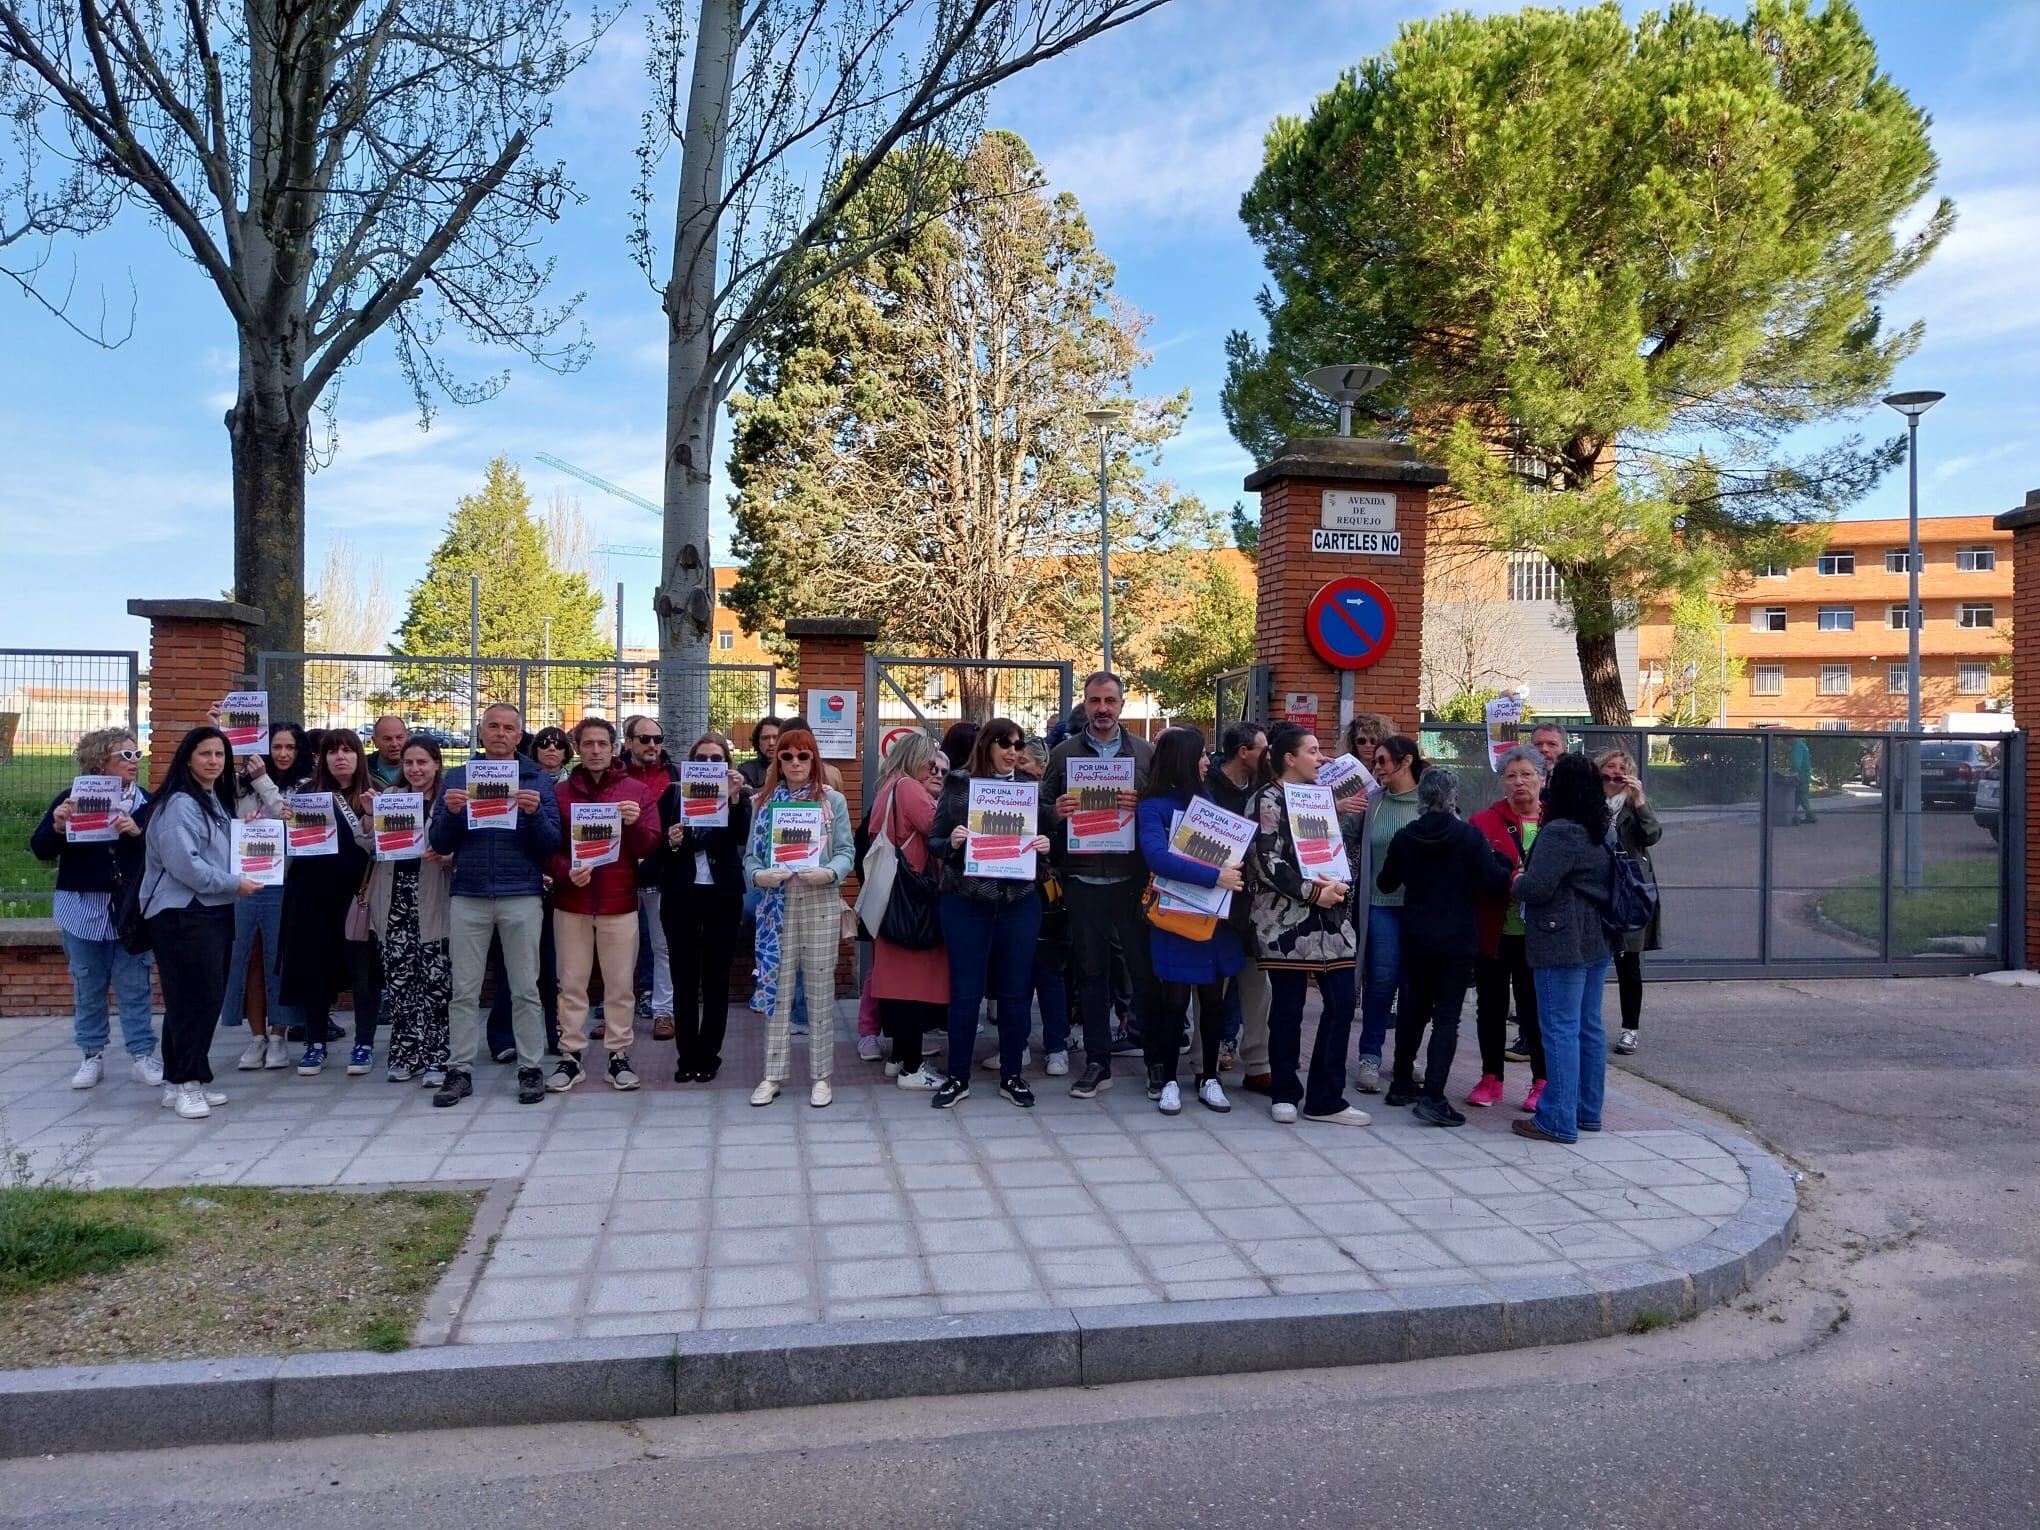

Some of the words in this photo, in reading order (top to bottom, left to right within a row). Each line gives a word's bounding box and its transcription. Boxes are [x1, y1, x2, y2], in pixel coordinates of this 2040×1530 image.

[1348, 496, 1386, 506] AVENIDA
[1336, 516, 1381, 525] REQUEJO
[1314, 532, 1378, 550] CARTELES
[1382, 535, 1399, 552] NO
[1074, 771, 1130, 782] ProFesional
[976, 795, 1032, 806] ProFesional
[1200, 808, 1215, 818] POR
[1215, 814, 1229, 826] UNA
[1191, 814, 1247, 843] ProFesional
